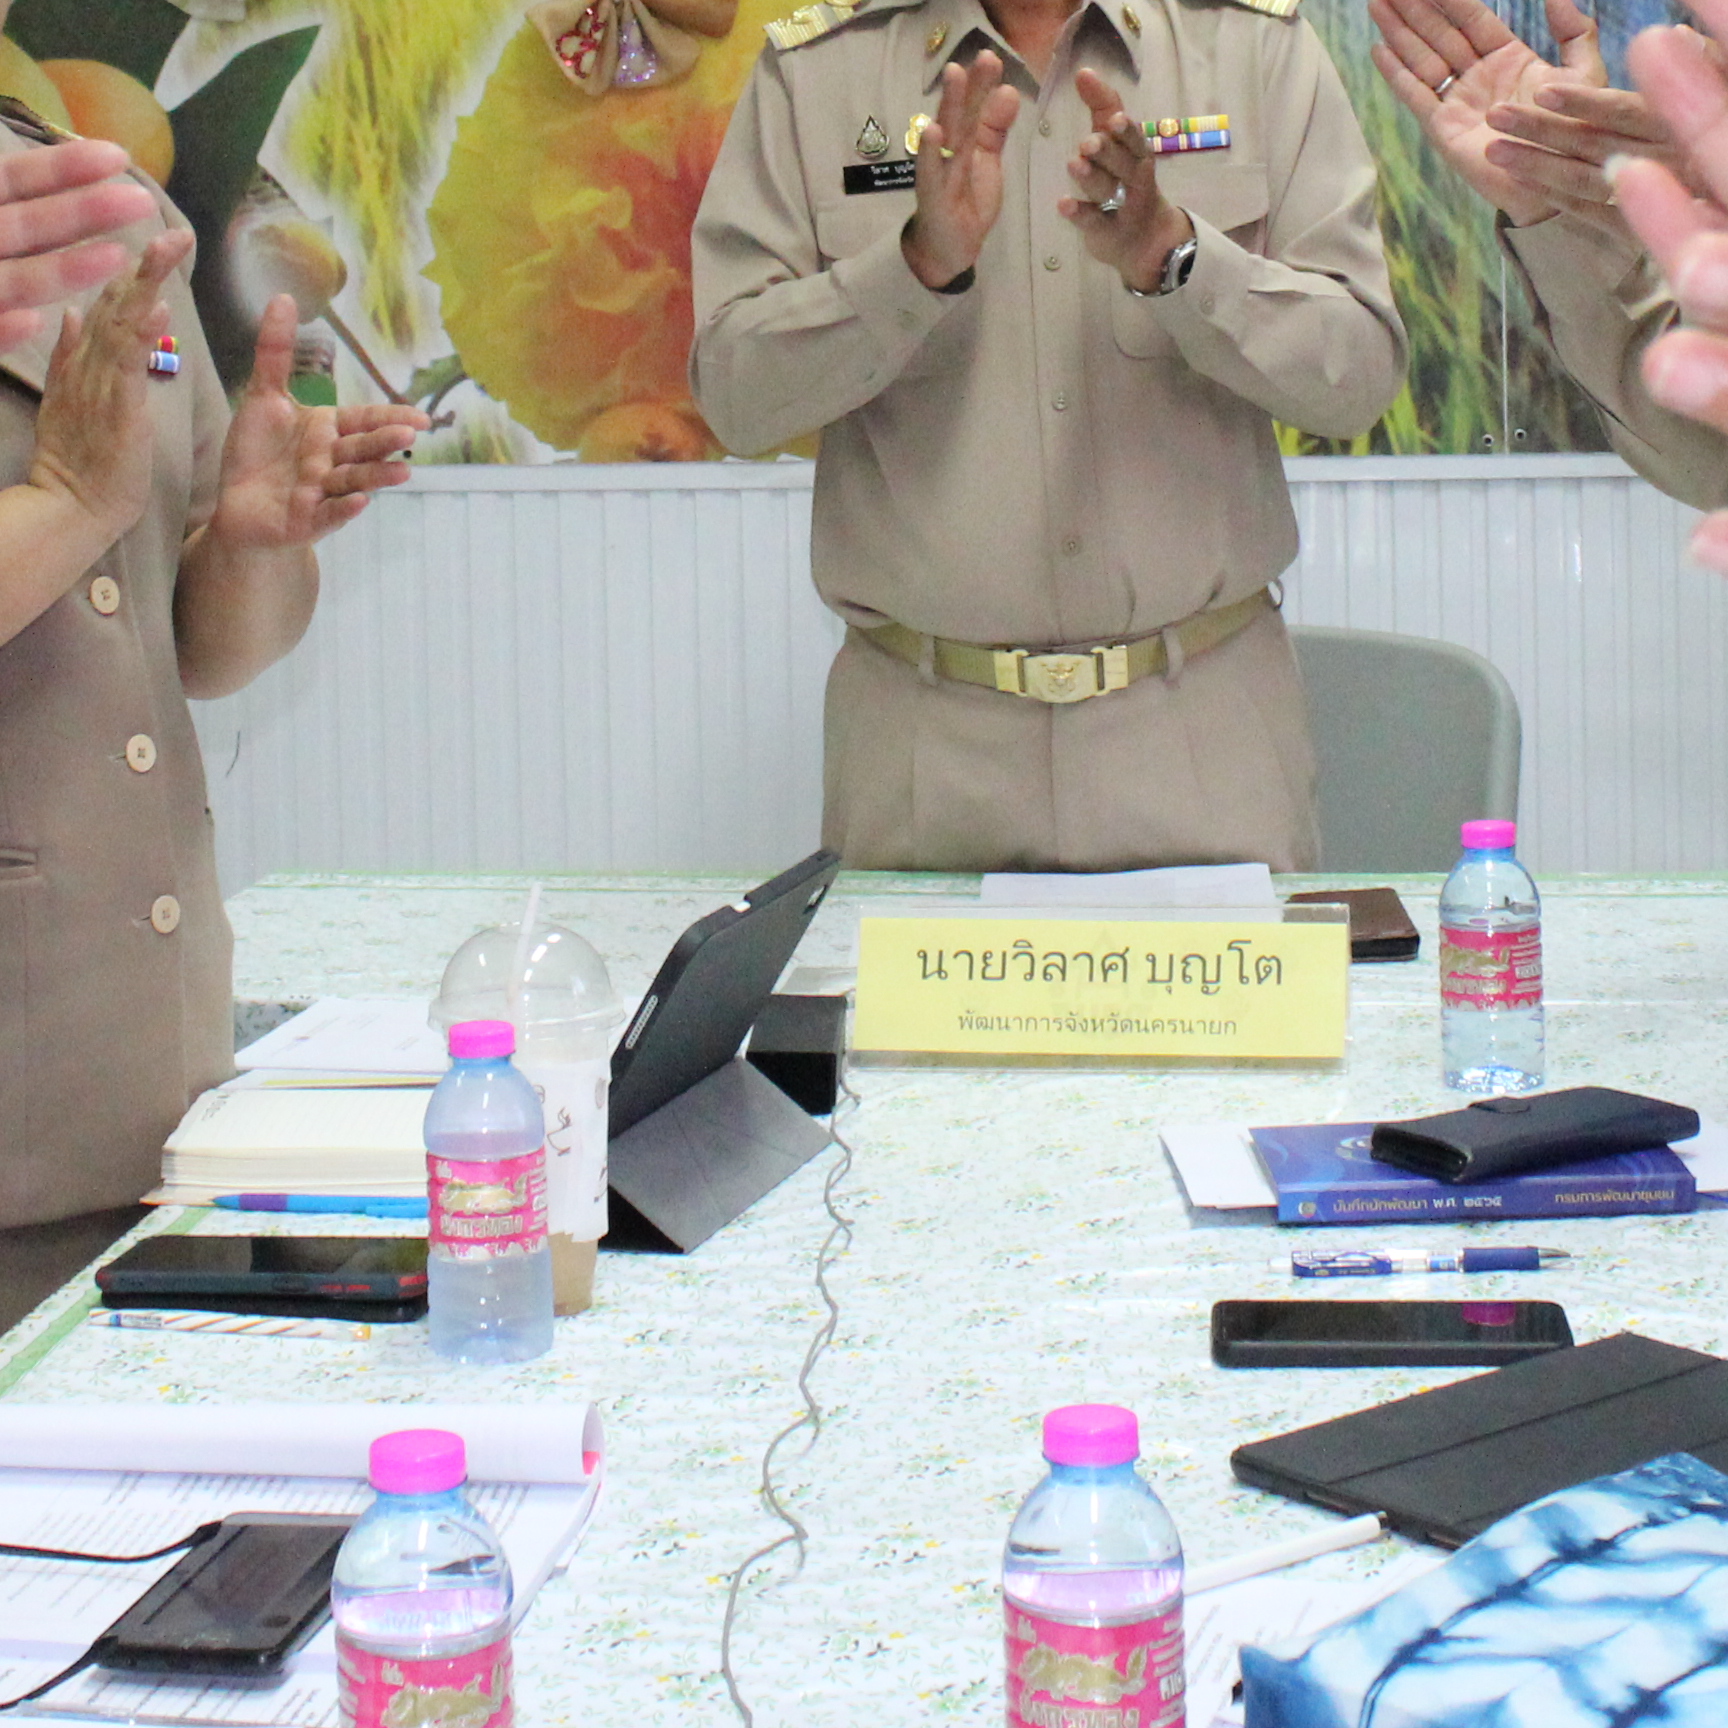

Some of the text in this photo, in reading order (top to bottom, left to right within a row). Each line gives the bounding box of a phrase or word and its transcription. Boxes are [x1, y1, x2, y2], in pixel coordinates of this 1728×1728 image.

[915, 939, 1283, 996] นายวิลาศ บุญโต
[957, 1010, 1238, 1037] พัฒนาการจังหวัดนครนายก
